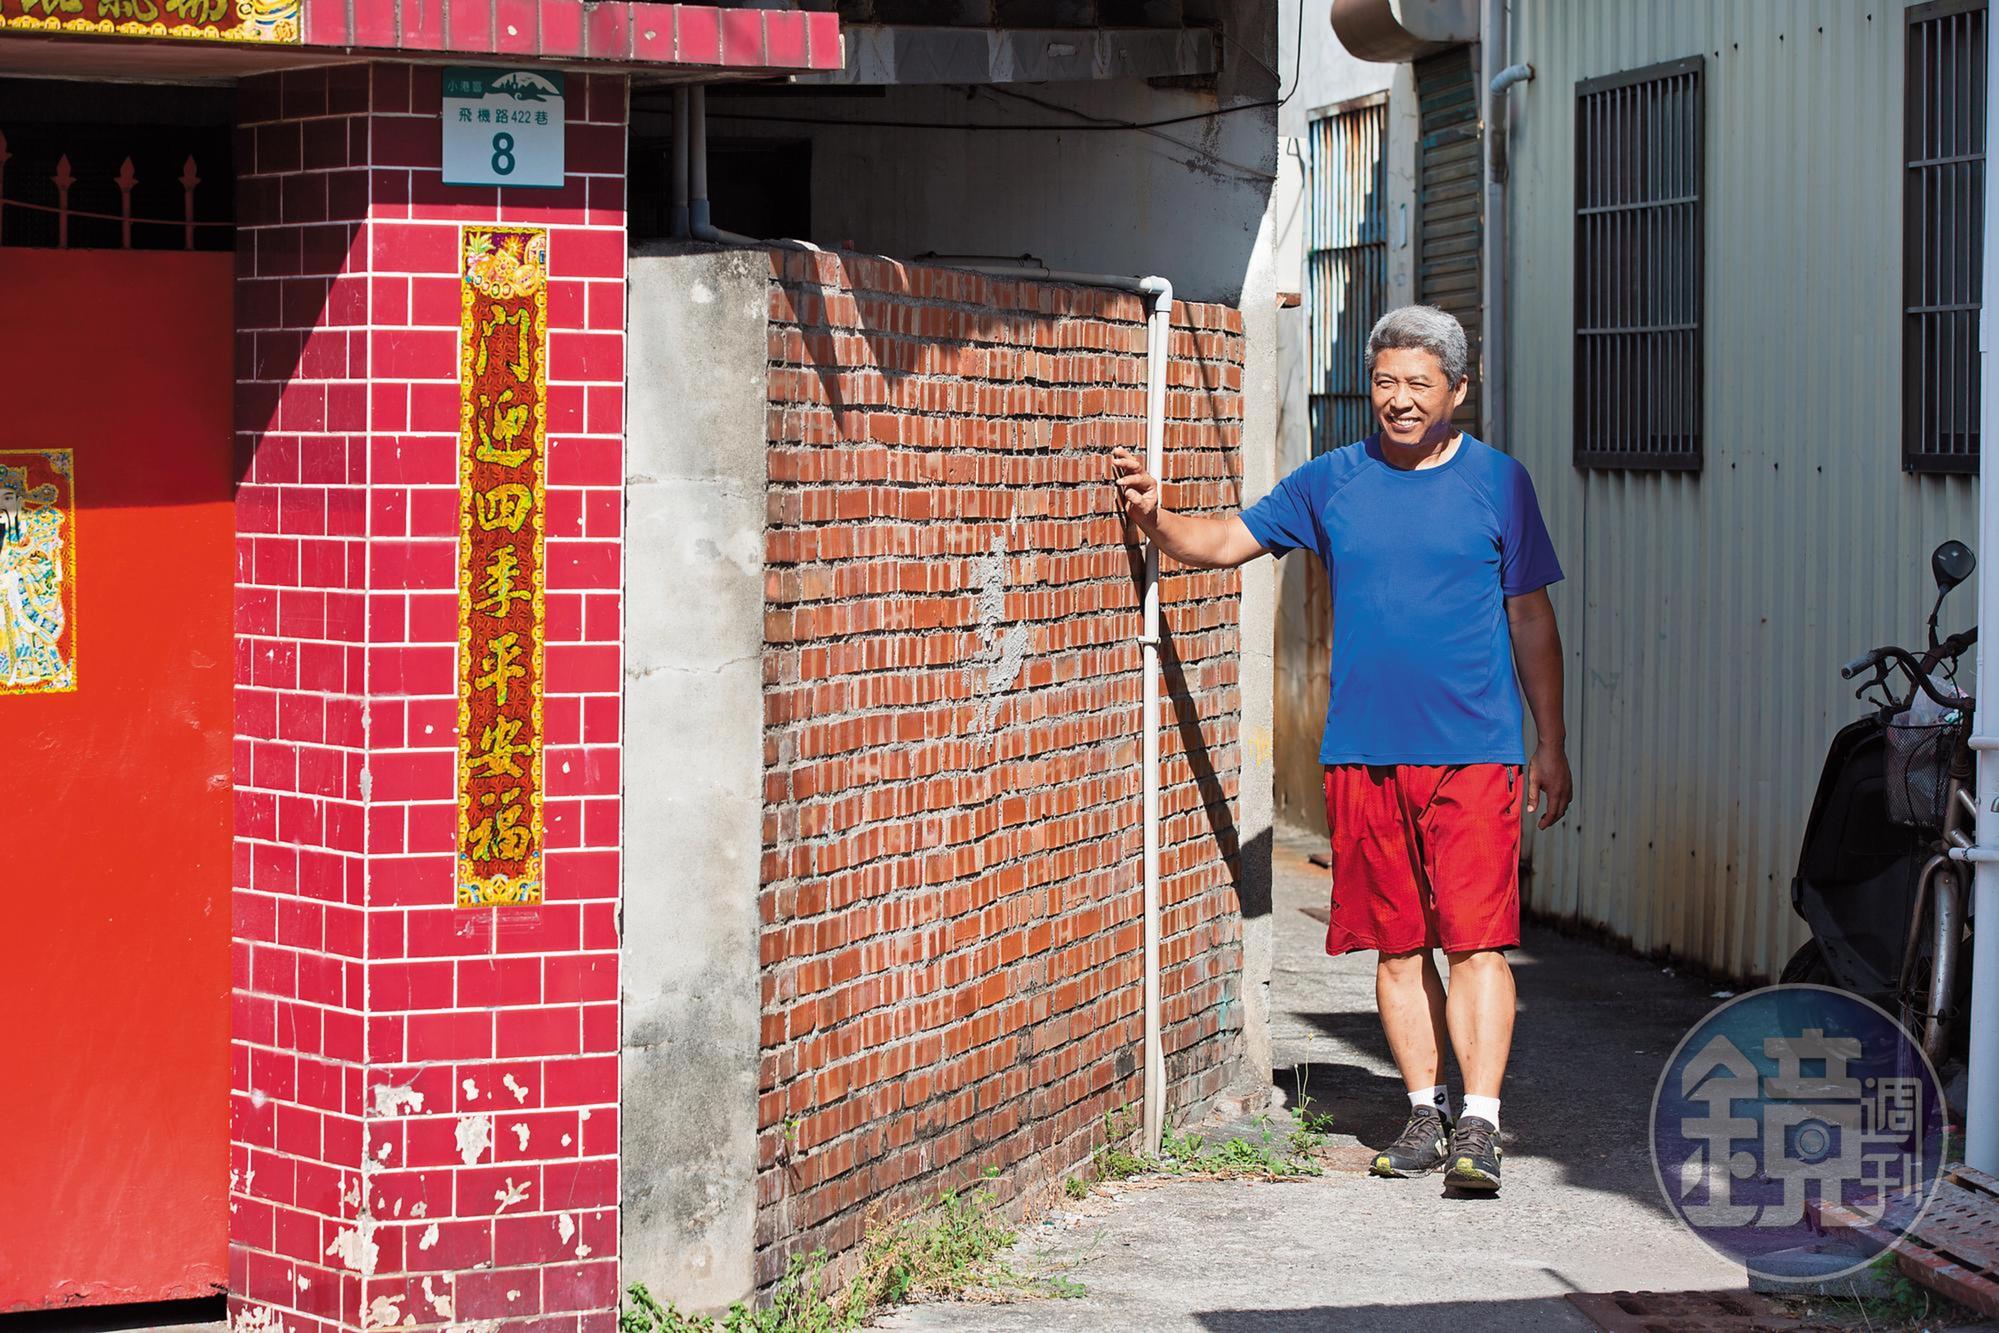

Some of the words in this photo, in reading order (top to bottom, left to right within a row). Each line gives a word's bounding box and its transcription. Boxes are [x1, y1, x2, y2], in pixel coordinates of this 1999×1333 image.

[459, 107, 548, 125] 飛機路422巷
[491, 132, 515, 176] 8
